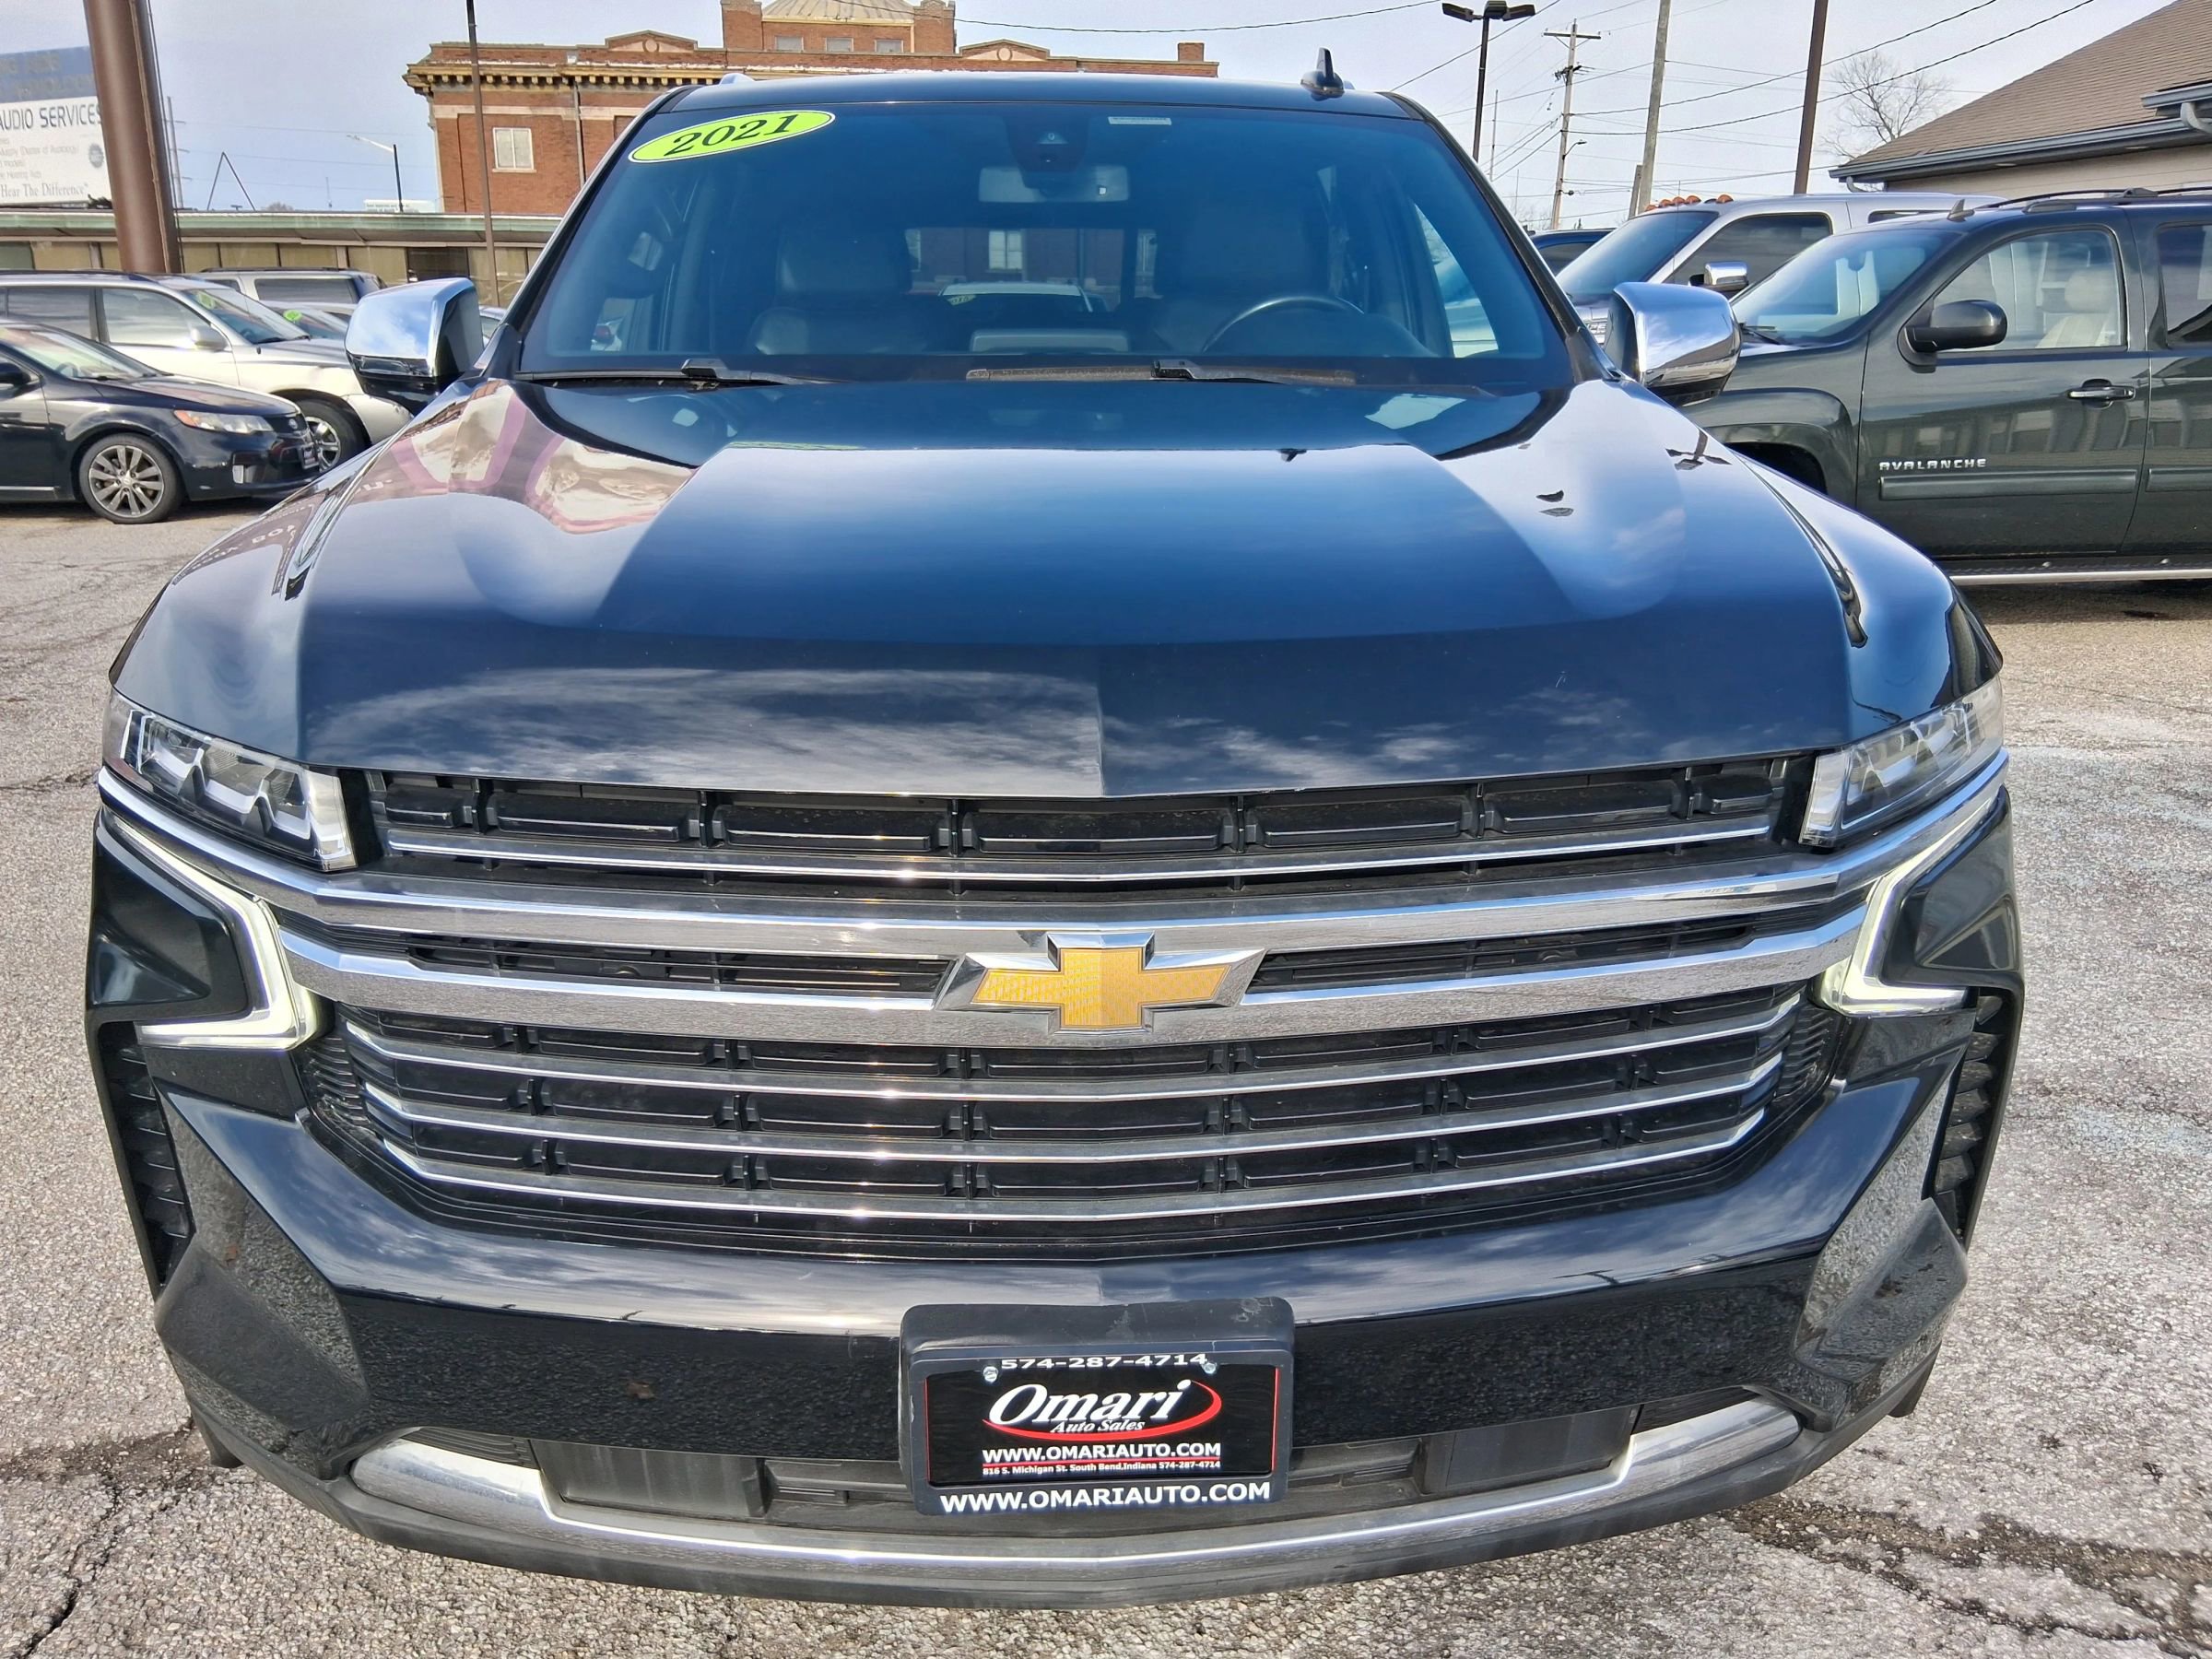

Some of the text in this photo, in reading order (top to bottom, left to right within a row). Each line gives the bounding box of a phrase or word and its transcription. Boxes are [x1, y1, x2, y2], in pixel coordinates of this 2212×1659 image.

[663, 114, 799, 157] 2021
[1878, 458, 1987, 471] AVALANCHE
[1001, 1353, 1207, 1370] 574-287-4714
[989, 1379, 1192, 1425] Omari
[1050, 1418, 1146, 1433] Auto Sales
[982, 1442, 1221, 1464] WWW.OMARIAUTO.COM
[1012, 1465, 1053, 1474] Michigan
[1069, 1463, 1097, 1472] South
[1159, 1461, 1221, 1469] 574-287-4714
[940, 1482, 1271, 1513] WWW.OMARIAUTO.COM
